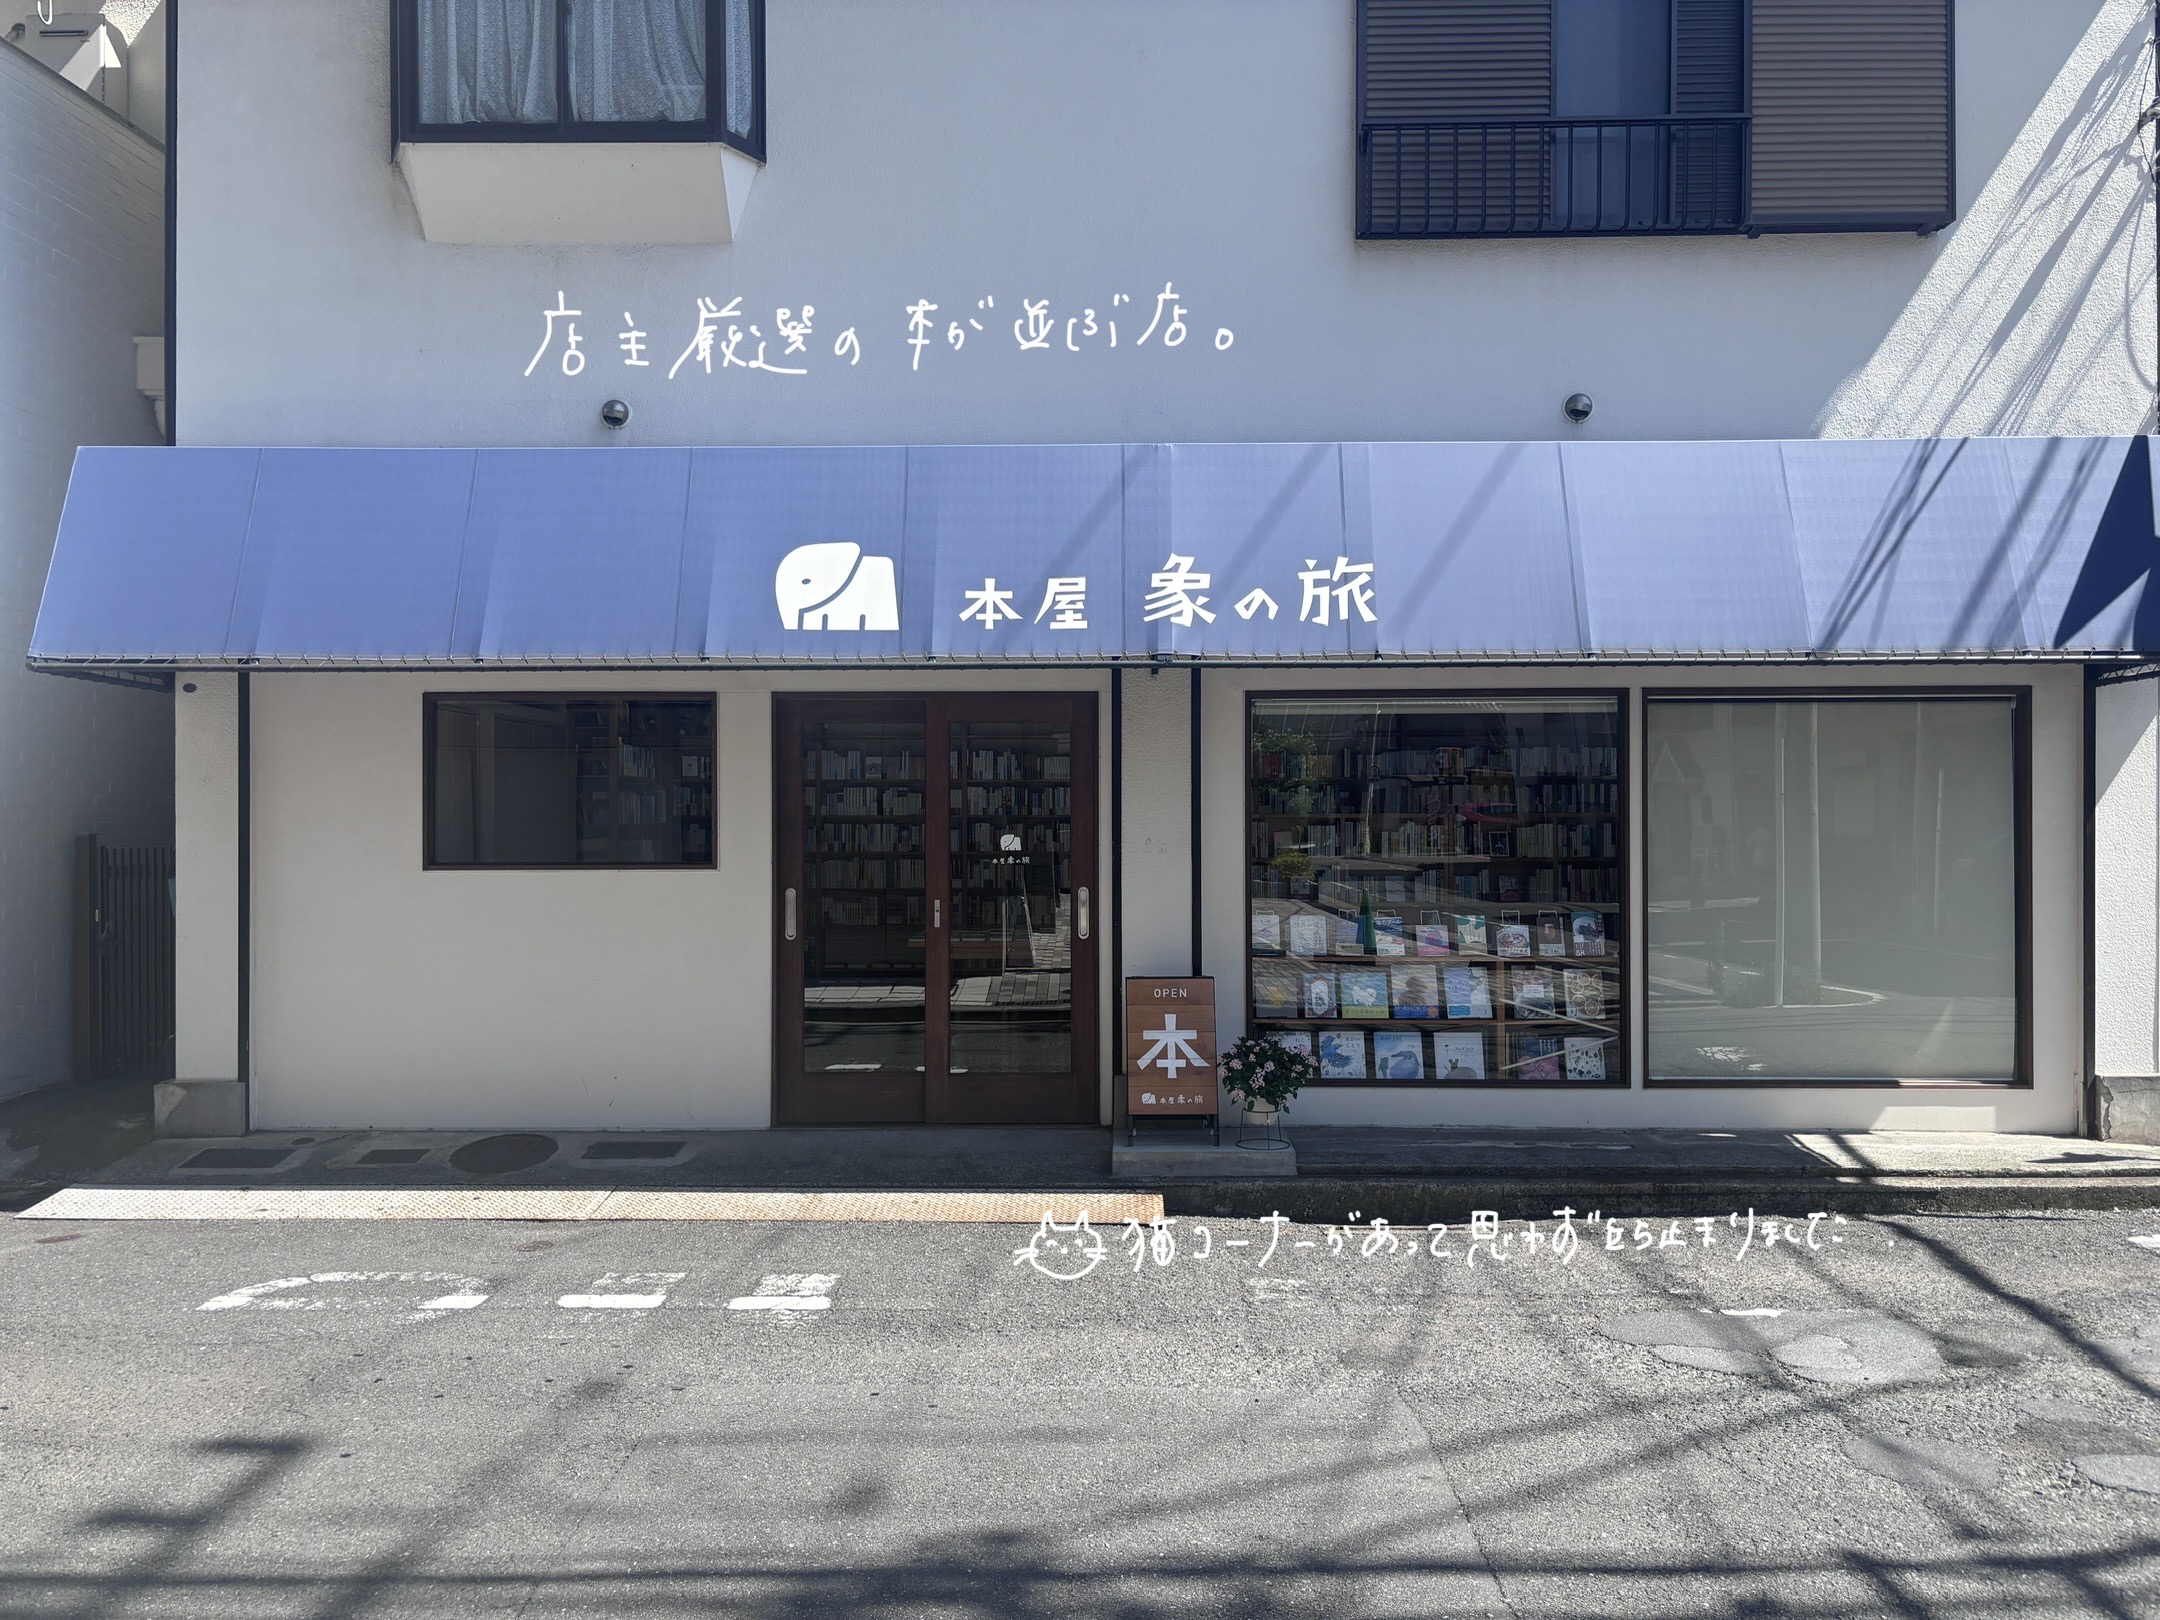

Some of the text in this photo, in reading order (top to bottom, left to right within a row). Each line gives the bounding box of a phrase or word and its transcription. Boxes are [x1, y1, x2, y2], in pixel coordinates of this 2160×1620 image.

[959, 552, 1378, 630] 本屋 象の旅
[1153, 988, 1187, 998] OPEN
[1136, 1013, 1211, 1079] 本
[1177, 1093, 1204, 1105] 象の旅
